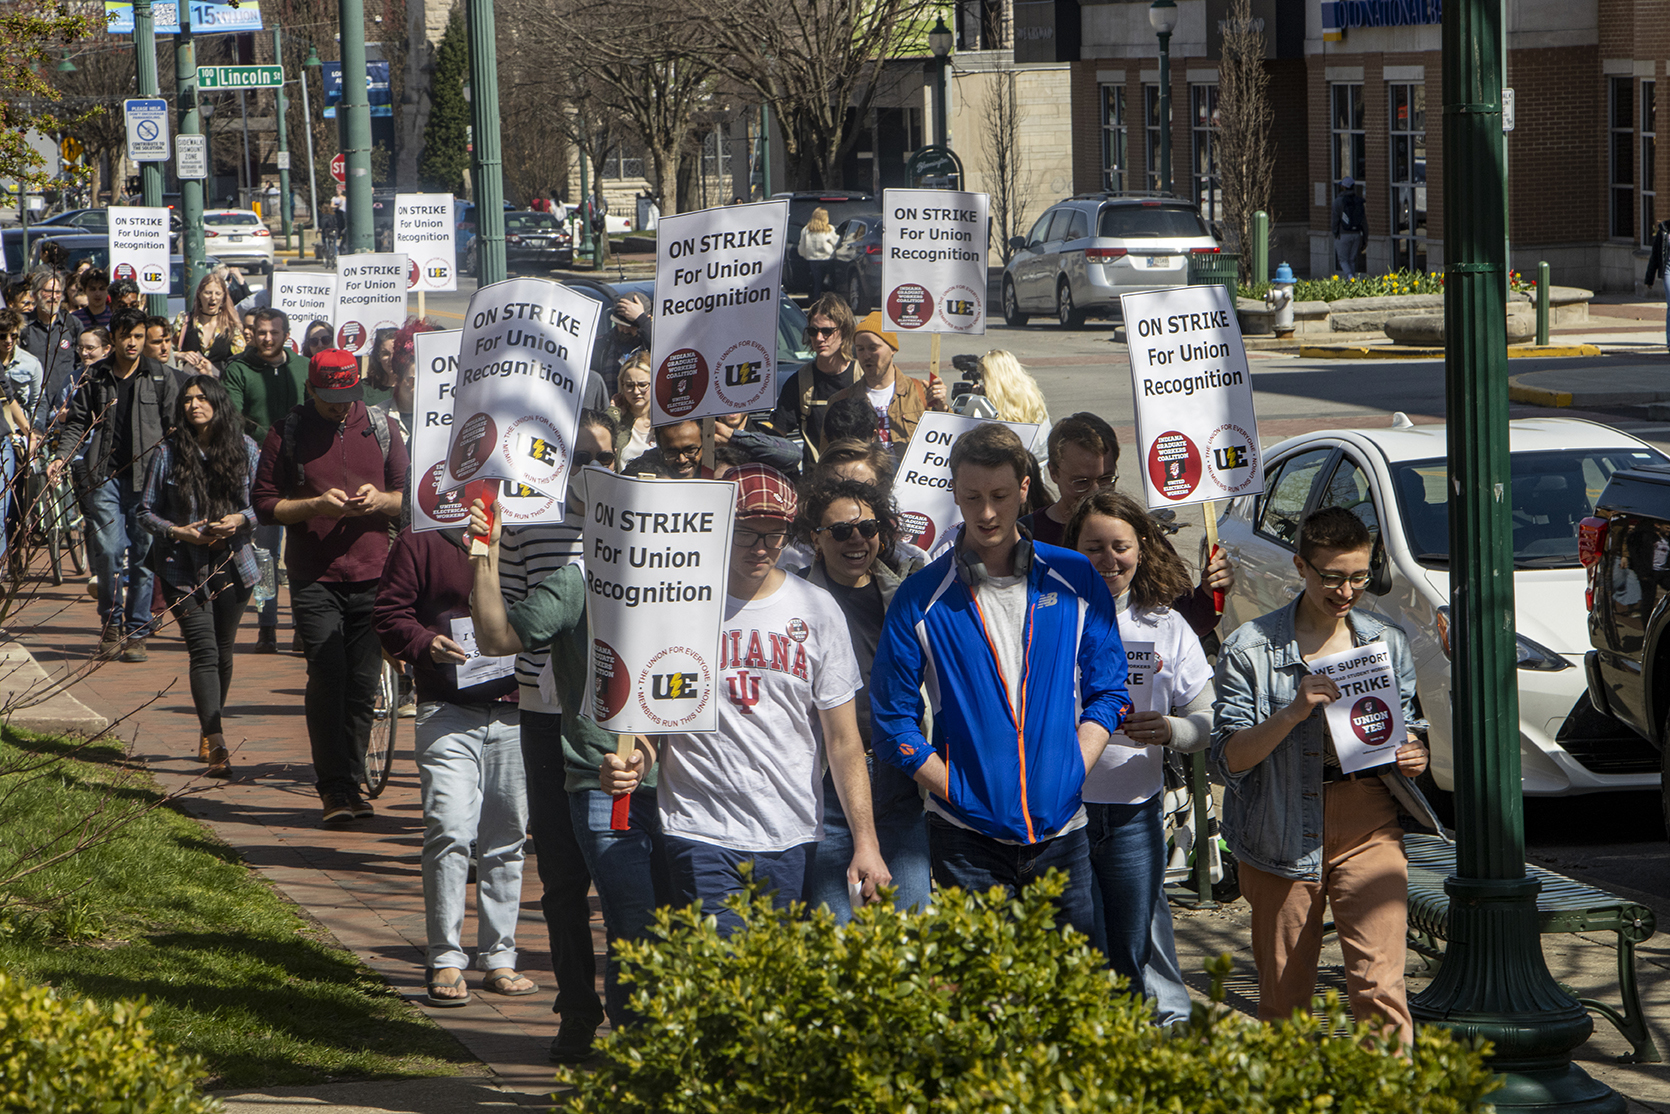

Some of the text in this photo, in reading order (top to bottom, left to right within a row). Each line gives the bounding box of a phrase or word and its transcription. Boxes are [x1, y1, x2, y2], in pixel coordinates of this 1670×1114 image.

[1365, 0, 1427, 27] NATIONAL
[201, 68, 214, 78] 100
[220, 68, 281, 85] Lincoln St
[206, 78, 211, 86] N
[333, 162, 345, 174] ST
[398, 206, 446, 214] ON STRIKE
[894, 208, 977, 222] ON STRIKE
[115, 218, 162, 226] ON STRIKE
[400, 219, 443, 228] For Union
[398, 232, 450, 243] Recognition
[669, 228, 772, 259] ON STRIKE
[900, 228, 972, 242] For Union
[114, 241, 164, 250] Recognition
[892, 247, 979, 262] Recognition
[344, 266, 401, 277] ON STRIKE
[674, 259, 762, 286] For Union
[280, 285, 330, 295] ON STRIKE
[346, 280, 396, 290] For Union
[282, 298, 325, 308] For Union
[340, 294, 402, 305] Recognition
[662, 286, 770, 317] Recognition
[946, 300, 974, 316] UE
[287, 313, 329, 322] cognition
[474, 303, 580, 338] ON STRIKE
[1138, 310, 1230, 338] ON STRIKE
[475, 330, 568, 361] For Union
[1148, 341, 1230, 366] For Union
[714, 340, 772, 374] THE UNION FOR EVERYONE
[463, 359, 574, 394] Recognition
[726, 362, 761, 387] UE
[1144, 369, 1242, 396] Recognition
[439, 384, 456, 400] Fo
[714, 380, 733, 408] MEMBERS
[748, 394, 760, 406] THIS
[759, 374, 771, 395] UNION
[504, 415, 567, 458] THE UNION FOR EVERYONE
[925, 430, 953, 446] ON
[1208, 428, 1221, 444] UNION
[1232, 424, 1256, 453] EVERYONE
[1214, 445, 1248, 470] UE
[550, 463, 564, 481] UNION
[1207, 464, 1227, 492] MEMBERS
[1240, 480, 1251, 490] THIS
[1249, 458, 1257, 478] UNION
[530, 509, 545, 518] THIS
[595, 502, 714, 534] ON STRIKE
[594, 538, 700, 568] For Union
[588, 570, 712, 608] Recognition
[638, 669, 649, 685] THE
[646, 649, 668, 668] UNION
[684, 648, 711, 682] EVERYONE
[1338, 652, 1388, 672] SUPPORT
[1347, 670, 1370, 679] STUDENT
[652, 672, 698, 700] UE
[638, 692, 660, 725] MEMBERS
[680, 713, 696, 726] THIS
[696, 689, 710, 714] UNION
[1352, 710, 1388, 726] UNION
[1362, 722, 1386, 734] YES!
